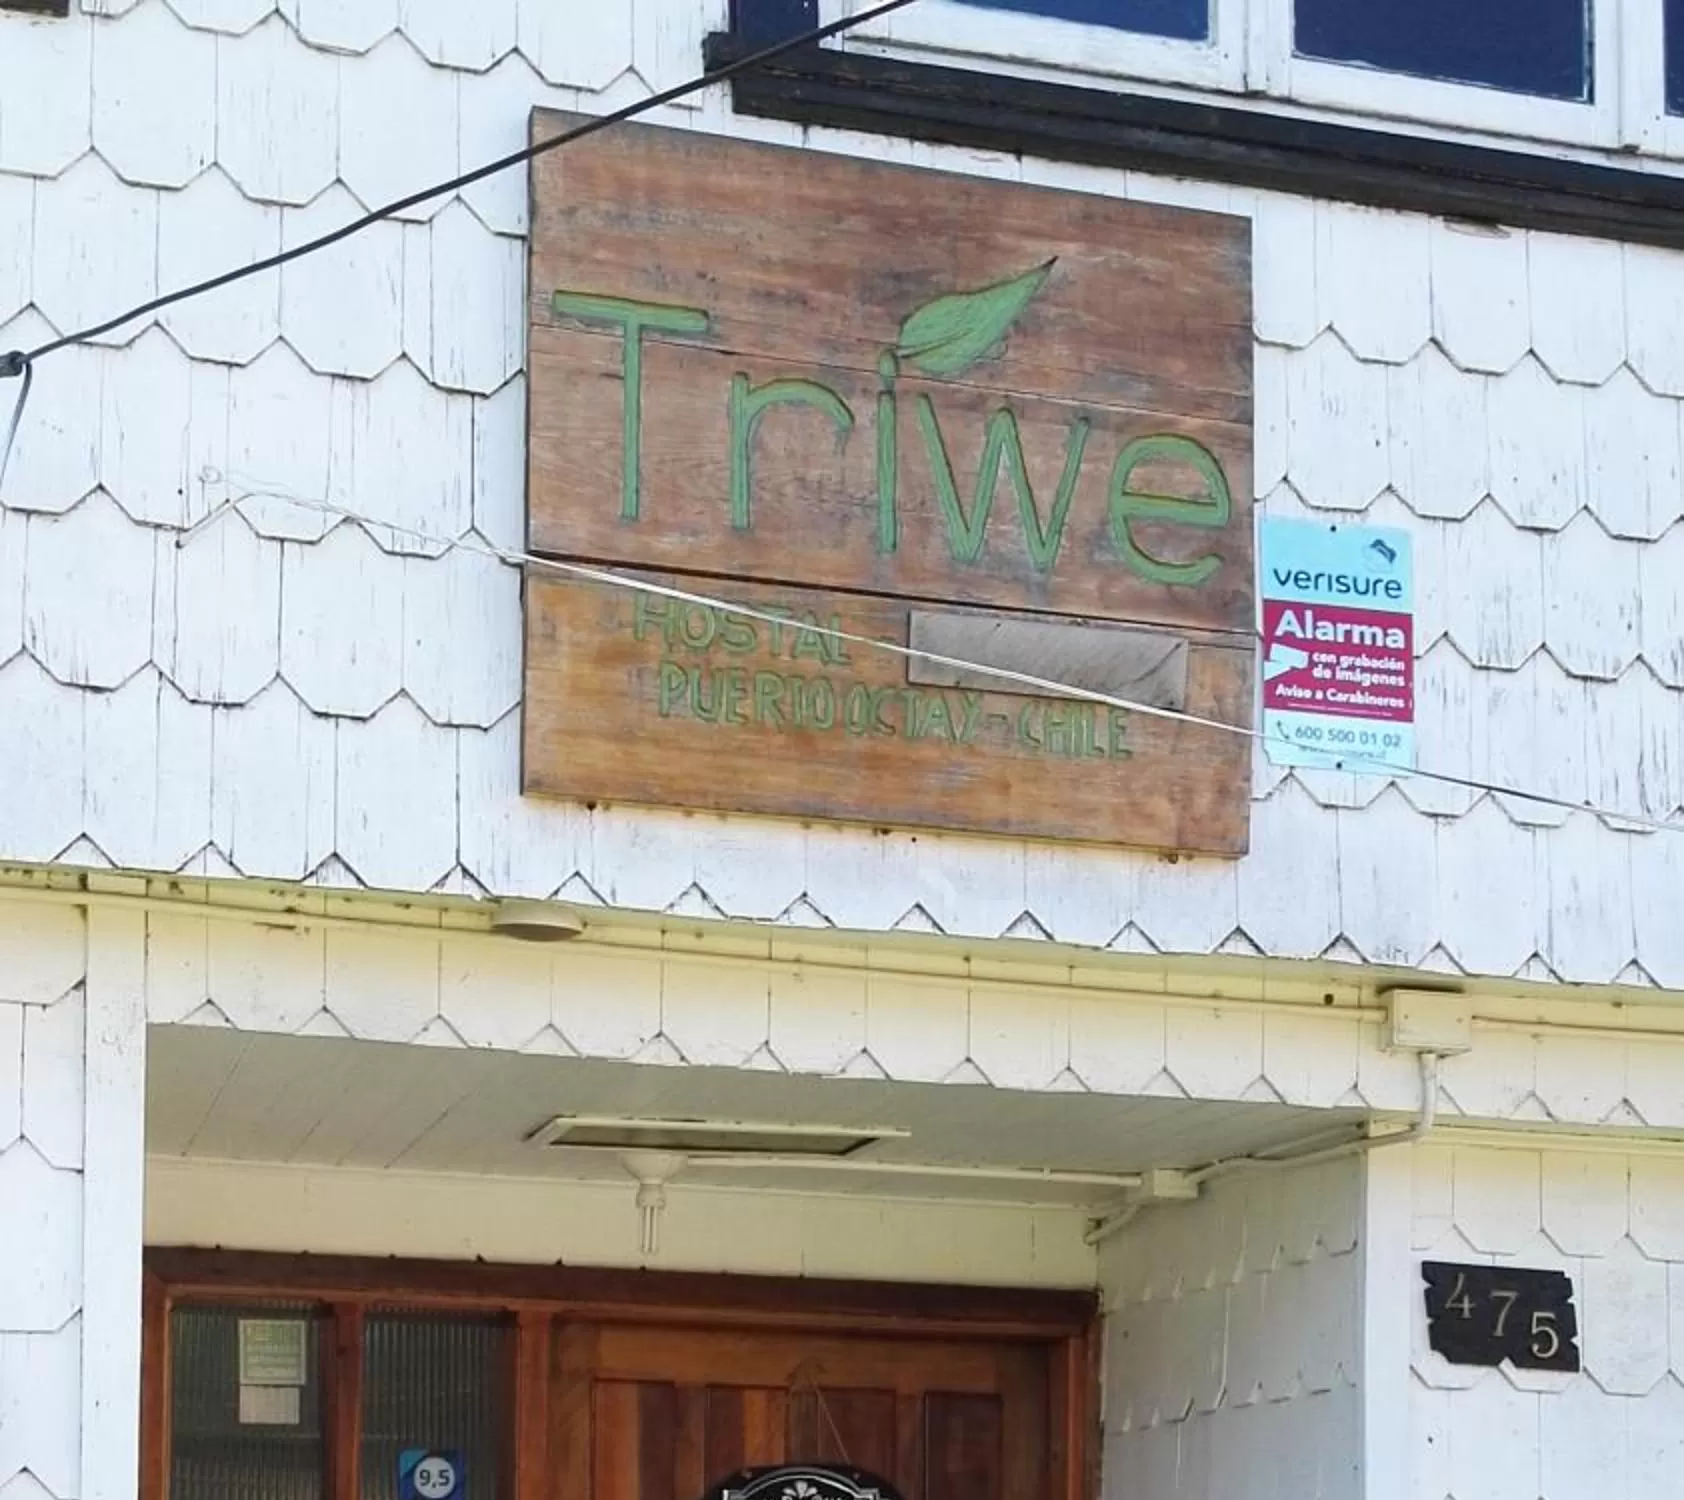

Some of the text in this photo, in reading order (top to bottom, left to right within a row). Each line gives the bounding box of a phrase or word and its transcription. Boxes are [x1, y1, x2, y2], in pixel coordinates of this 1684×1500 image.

[551, 289, 1231, 585] Triwe
[1273, 567, 1403, 599] verisure
[634, 588, 852, 665] HOSTAL
[1275, 609, 1405, 649] Alarma
[1312, 652, 1337, 664] con
[1312, 663, 1405, 687] de imágenes
[657, 660, 834, 733] PUERTO
[1275, 683, 1405, 708] Aviso a Carabineros
[1295, 726, 1402, 748] 600 500 01 02
[1444, 1271, 1560, 1359] 475
